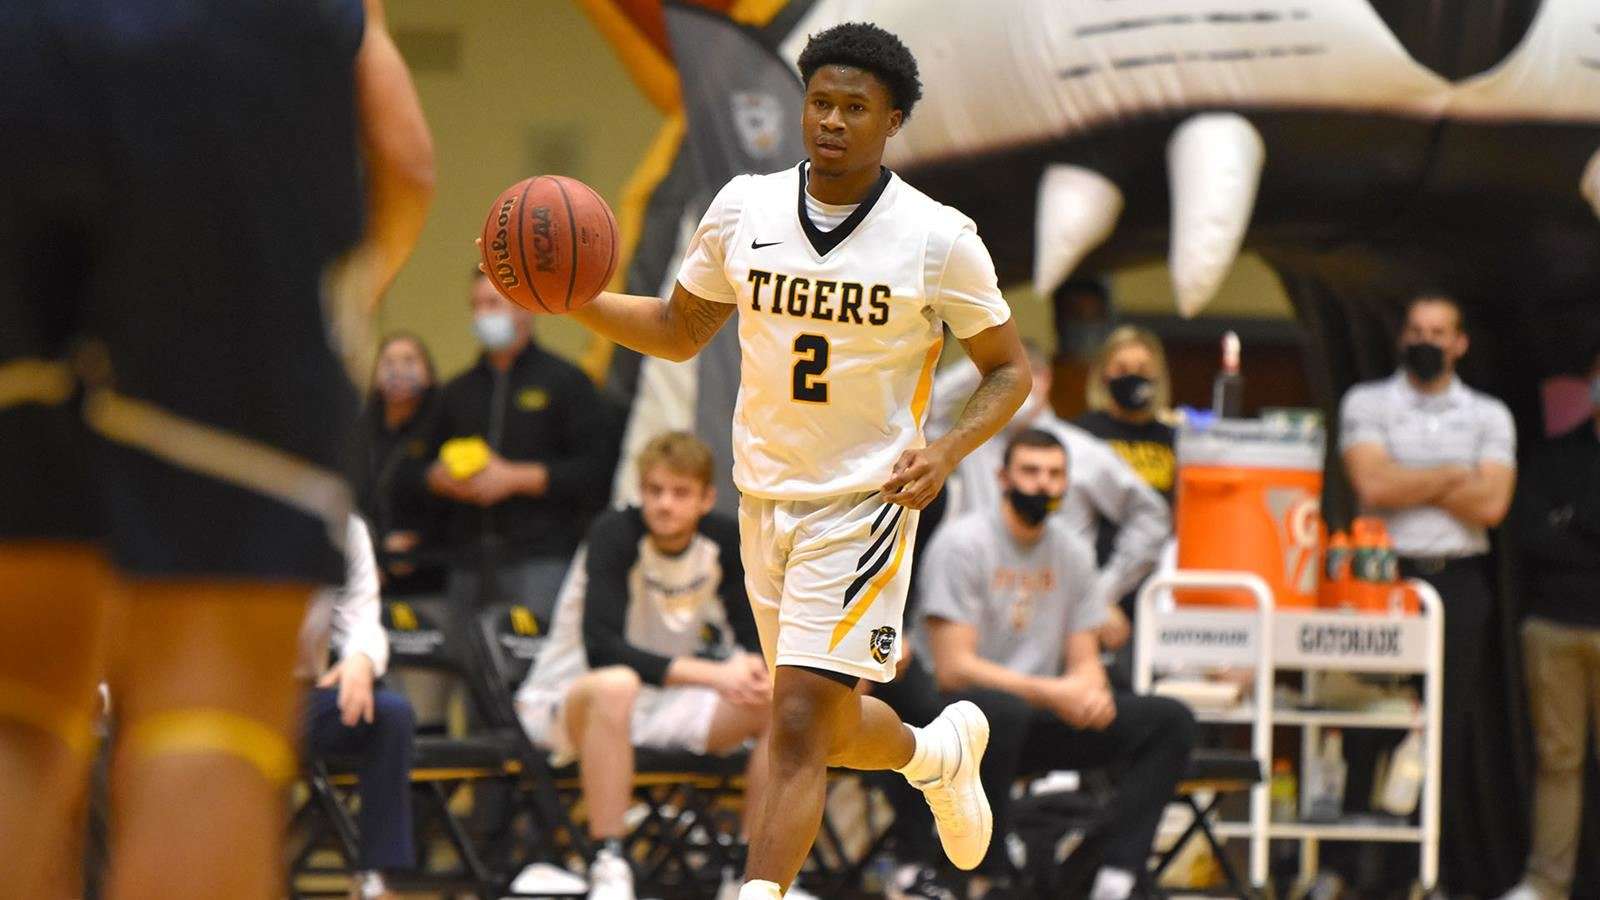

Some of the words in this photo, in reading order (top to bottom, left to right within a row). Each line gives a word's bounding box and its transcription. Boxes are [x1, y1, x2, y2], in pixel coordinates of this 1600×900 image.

[490, 196, 520, 289] Wilson
[532, 206, 557, 273] NCAA
[747, 268, 892, 326] TIGERS
[792, 332, 830, 404] 2
[1298, 624, 1402, 655] GATORADE
